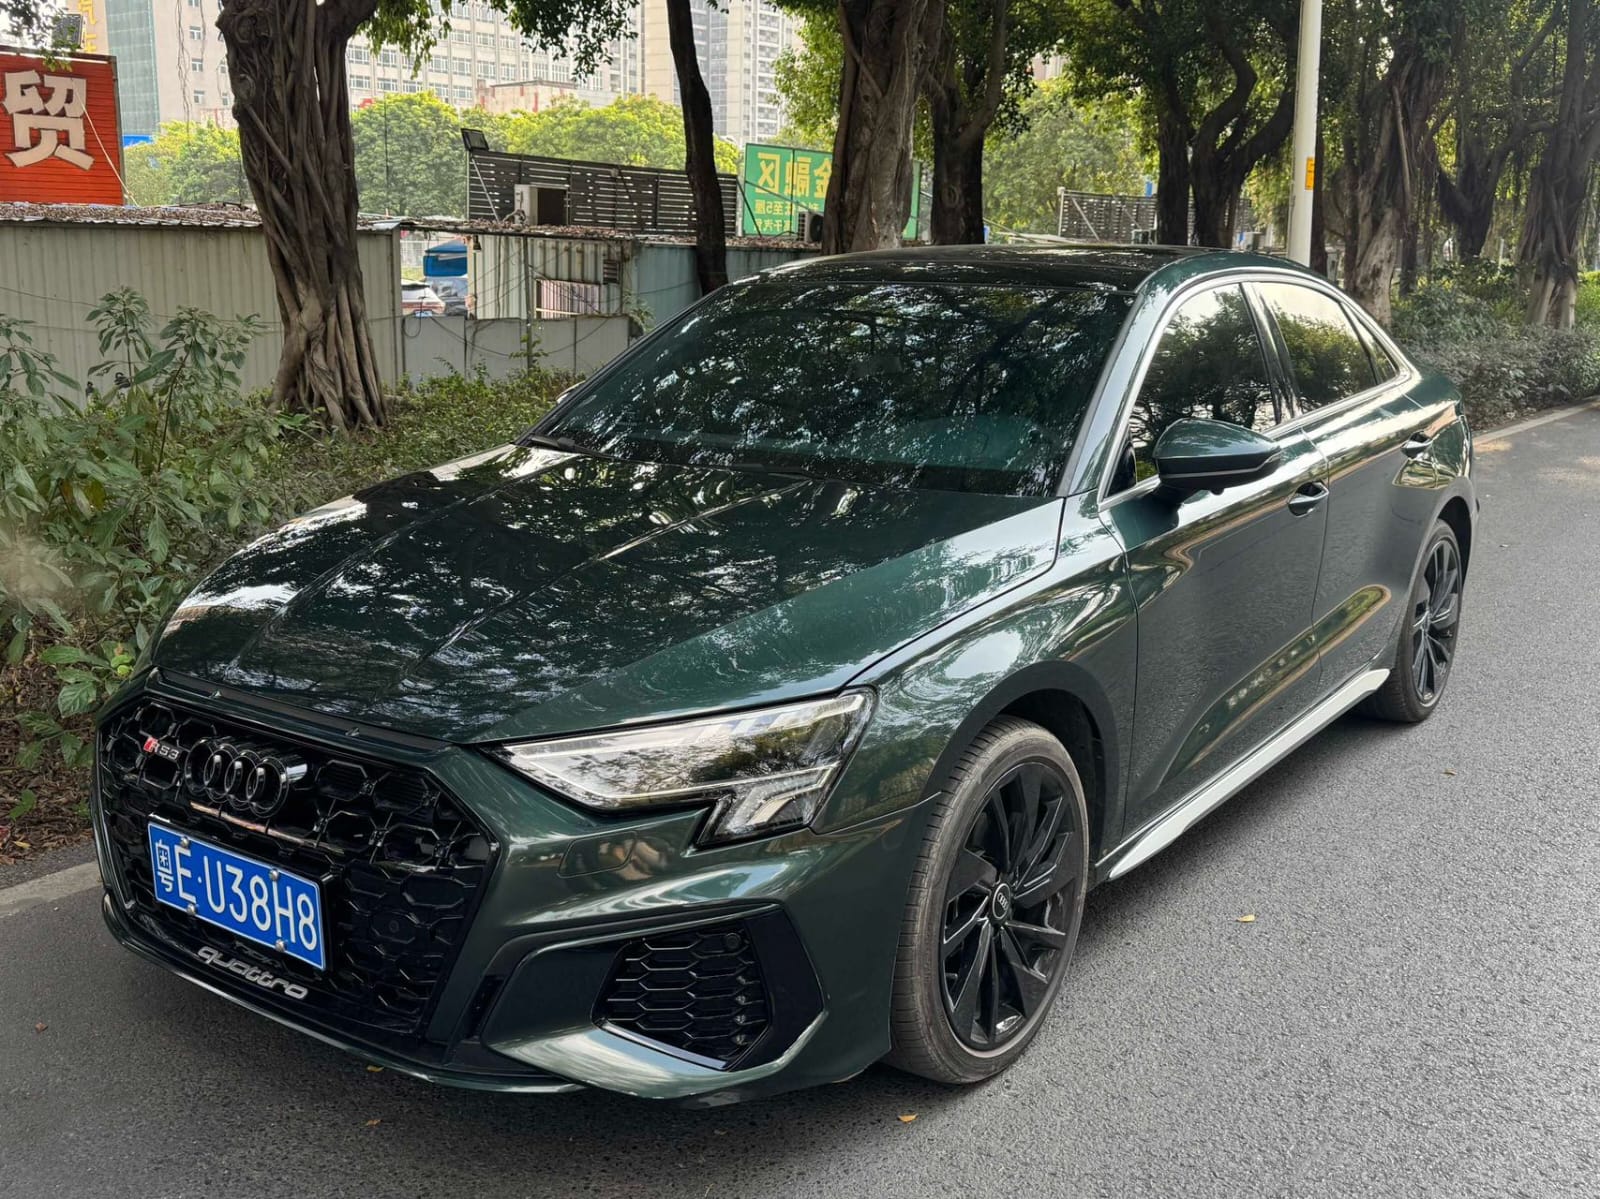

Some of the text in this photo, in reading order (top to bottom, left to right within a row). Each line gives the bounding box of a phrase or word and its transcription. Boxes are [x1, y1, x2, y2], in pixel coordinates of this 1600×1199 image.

[3, 70, 94, 171] 贸
[143, 736, 179, 759] RS3
[197, 945, 309, 1000] quattro
